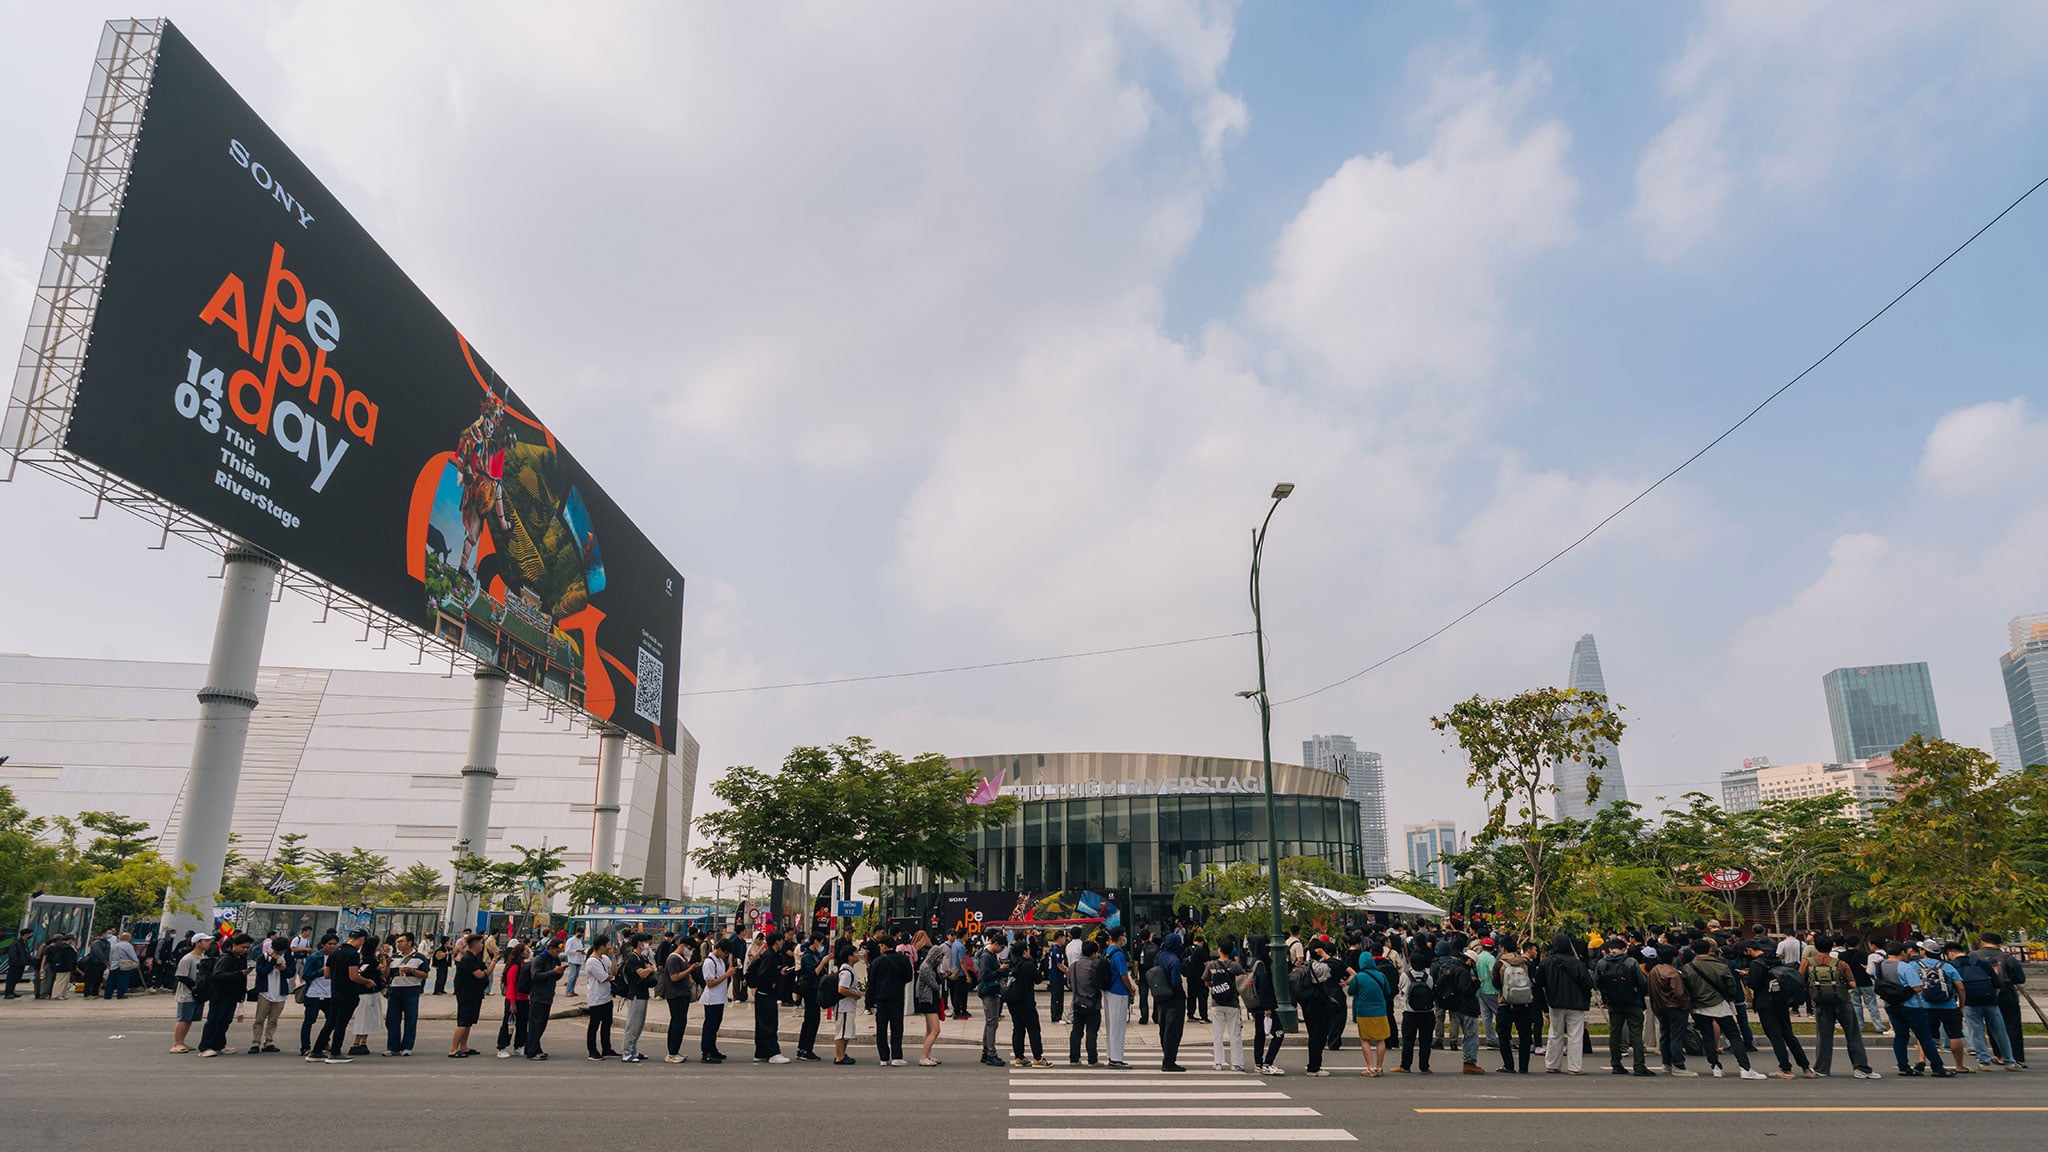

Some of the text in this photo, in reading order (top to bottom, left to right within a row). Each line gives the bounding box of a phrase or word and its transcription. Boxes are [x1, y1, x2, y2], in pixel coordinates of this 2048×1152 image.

[229, 138, 316, 230] SONY
[259, 241, 341, 353] be
[186, 349, 225, 401] 14
[199, 250, 380, 447] Alpha
[174, 382, 223, 434] 03
[228, 356, 350, 494] day
[220, 447, 271, 490] Thiêm
[224, 425, 257, 457] Thủ
[214, 469, 301, 529] RiverStage
[964, 908, 984, 922] be
